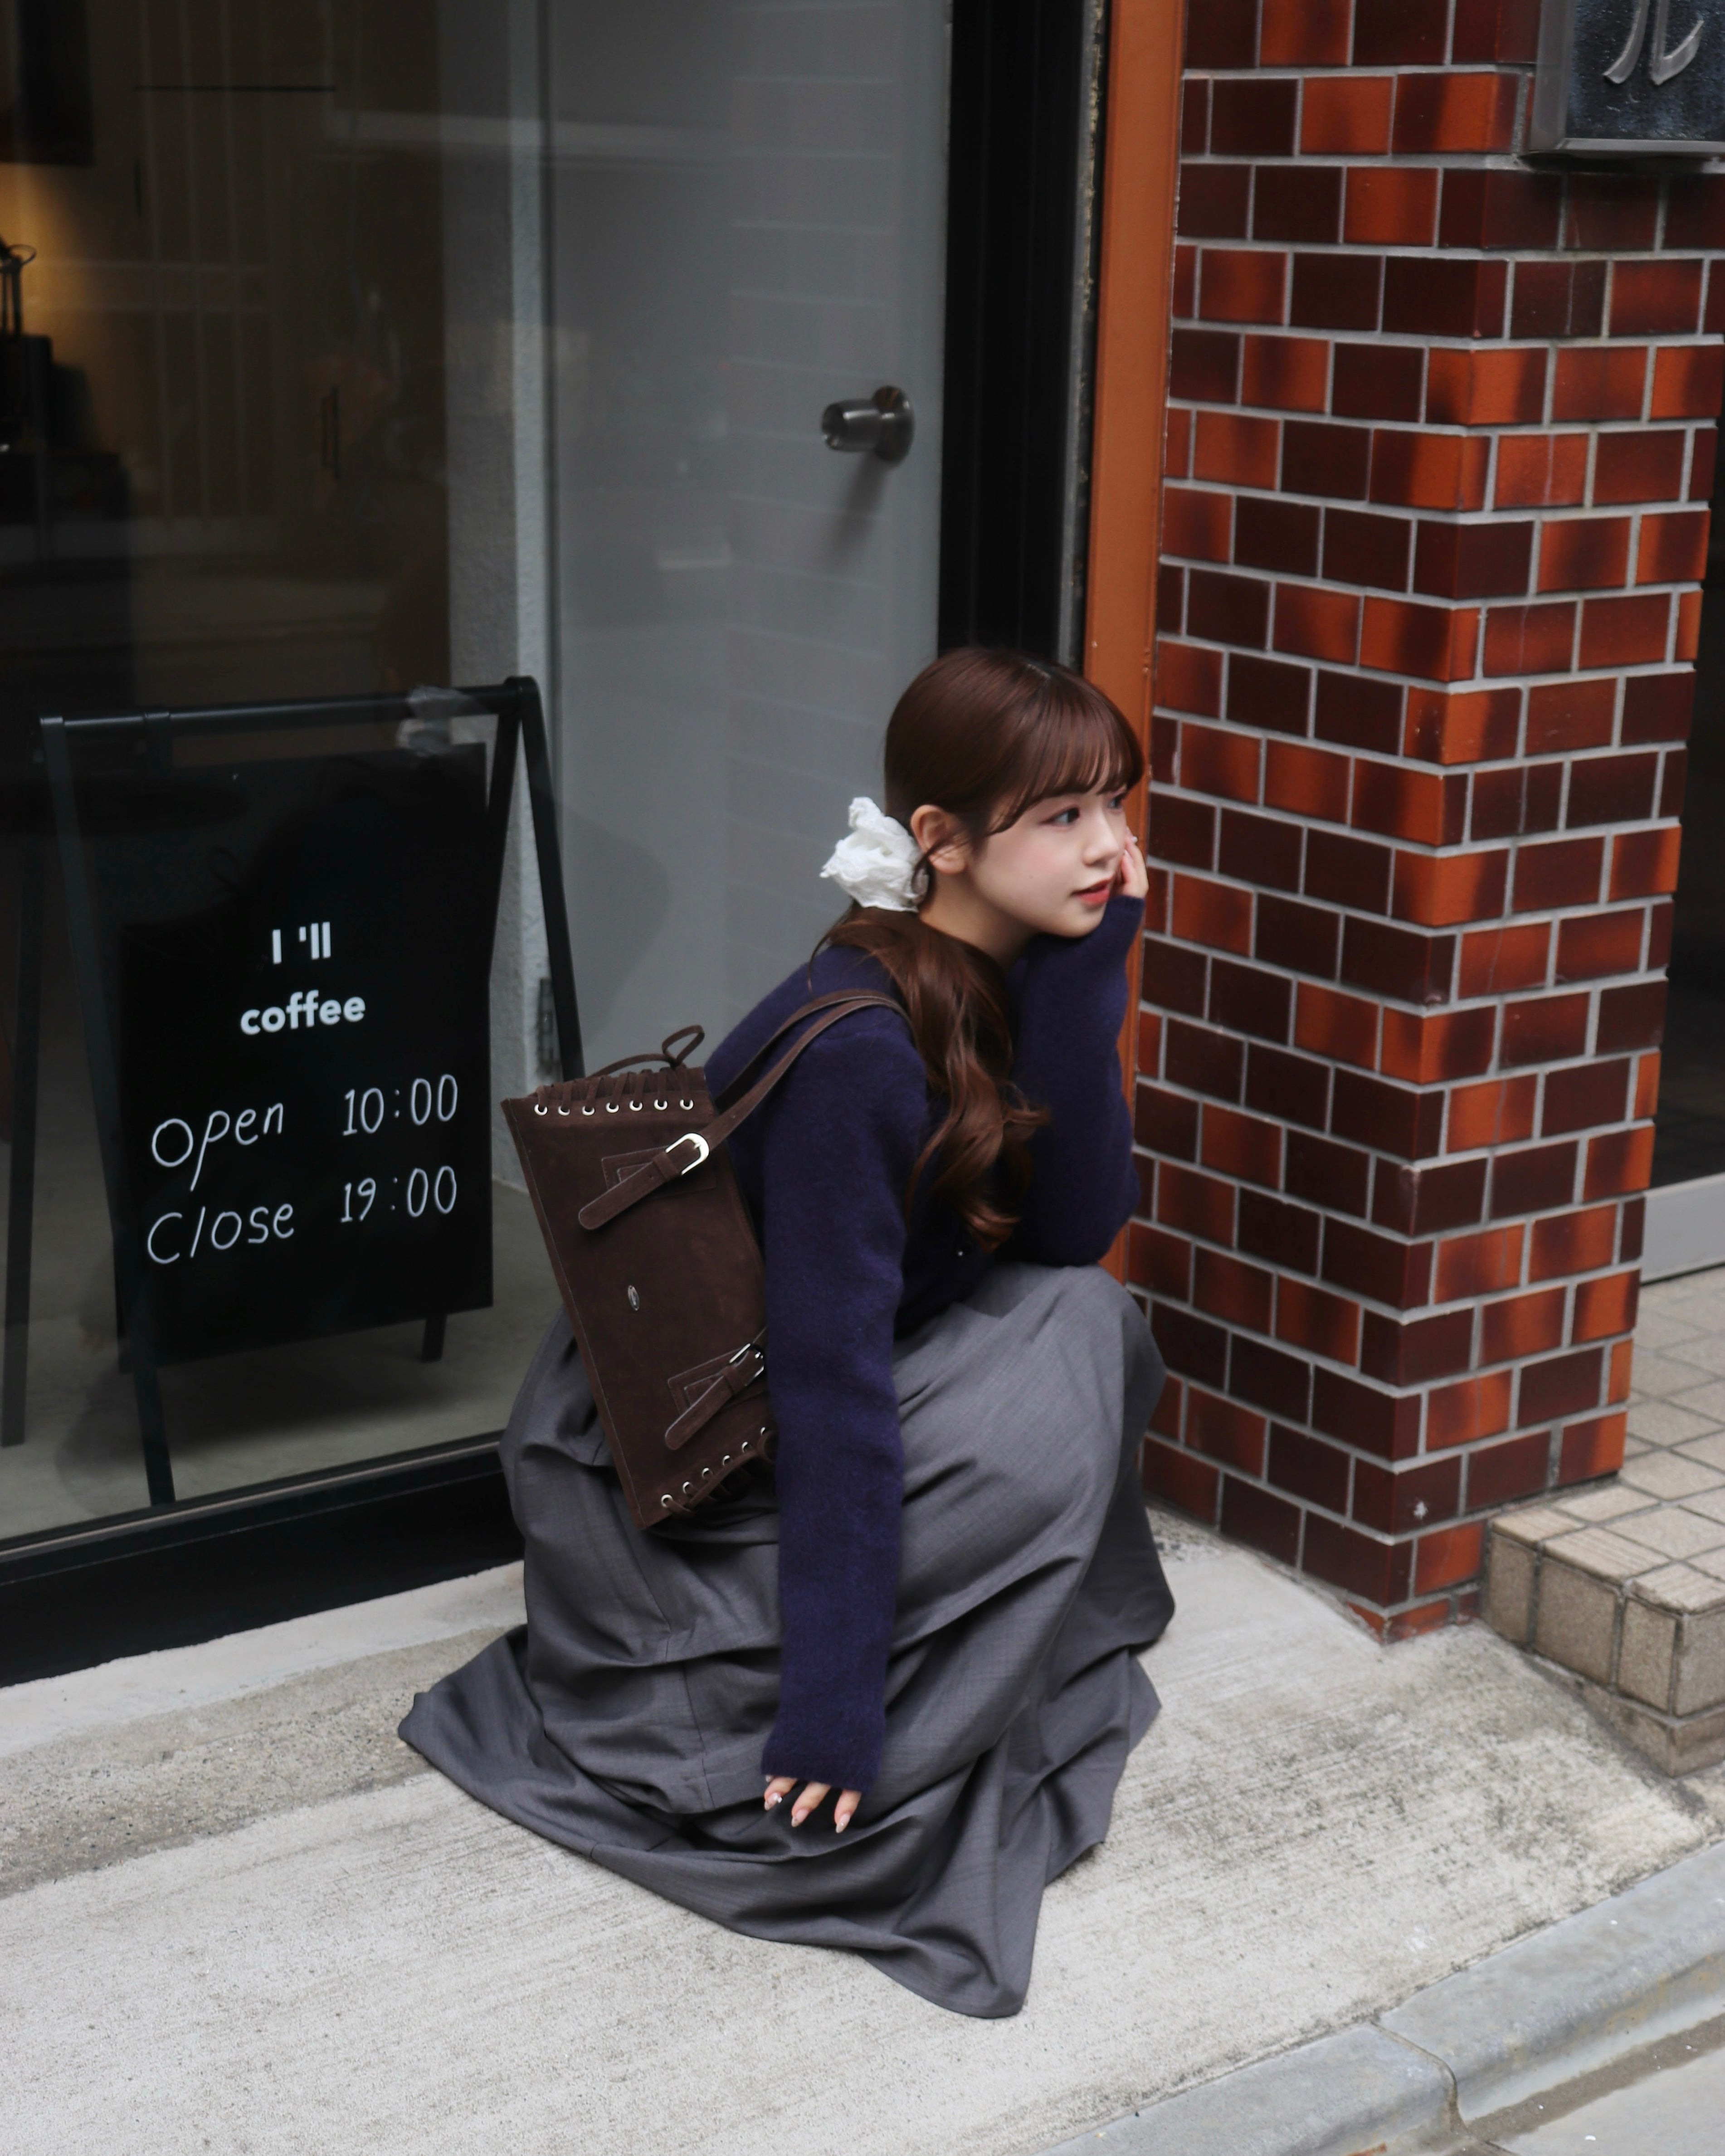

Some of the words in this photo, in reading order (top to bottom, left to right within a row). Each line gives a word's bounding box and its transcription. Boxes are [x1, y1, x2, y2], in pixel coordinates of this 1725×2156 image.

[240, 989, 366, 1035] coffee
[151, 1103, 284, 1192] Open
[342, 1074, 458, 1136] 10:00
[147, 1203, 294, 1264] Close
[341, 1166, 457, 1223] 19:00
